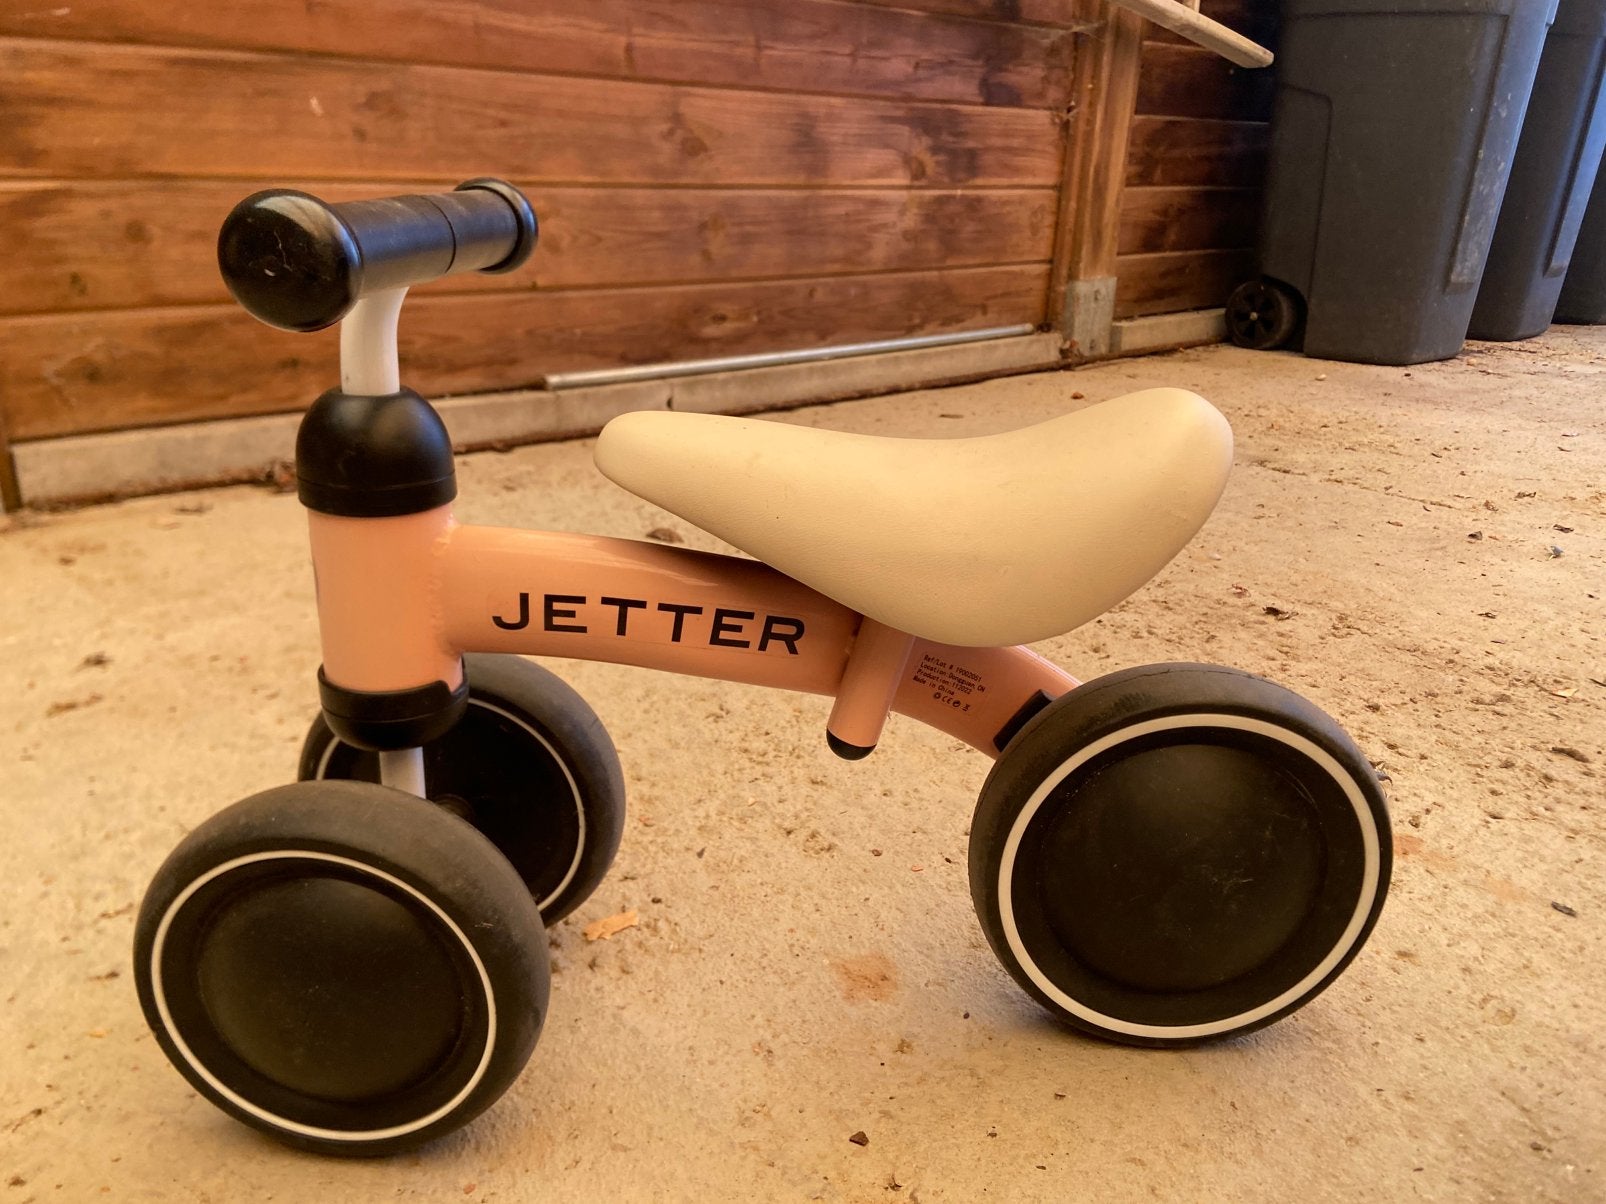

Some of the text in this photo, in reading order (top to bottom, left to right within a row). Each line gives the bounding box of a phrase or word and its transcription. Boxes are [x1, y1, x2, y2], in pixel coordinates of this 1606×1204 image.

[492, 592, 805, 655] JETTER
[913, 675, 926, 684] Made
[938, 684, 955, 696] China
